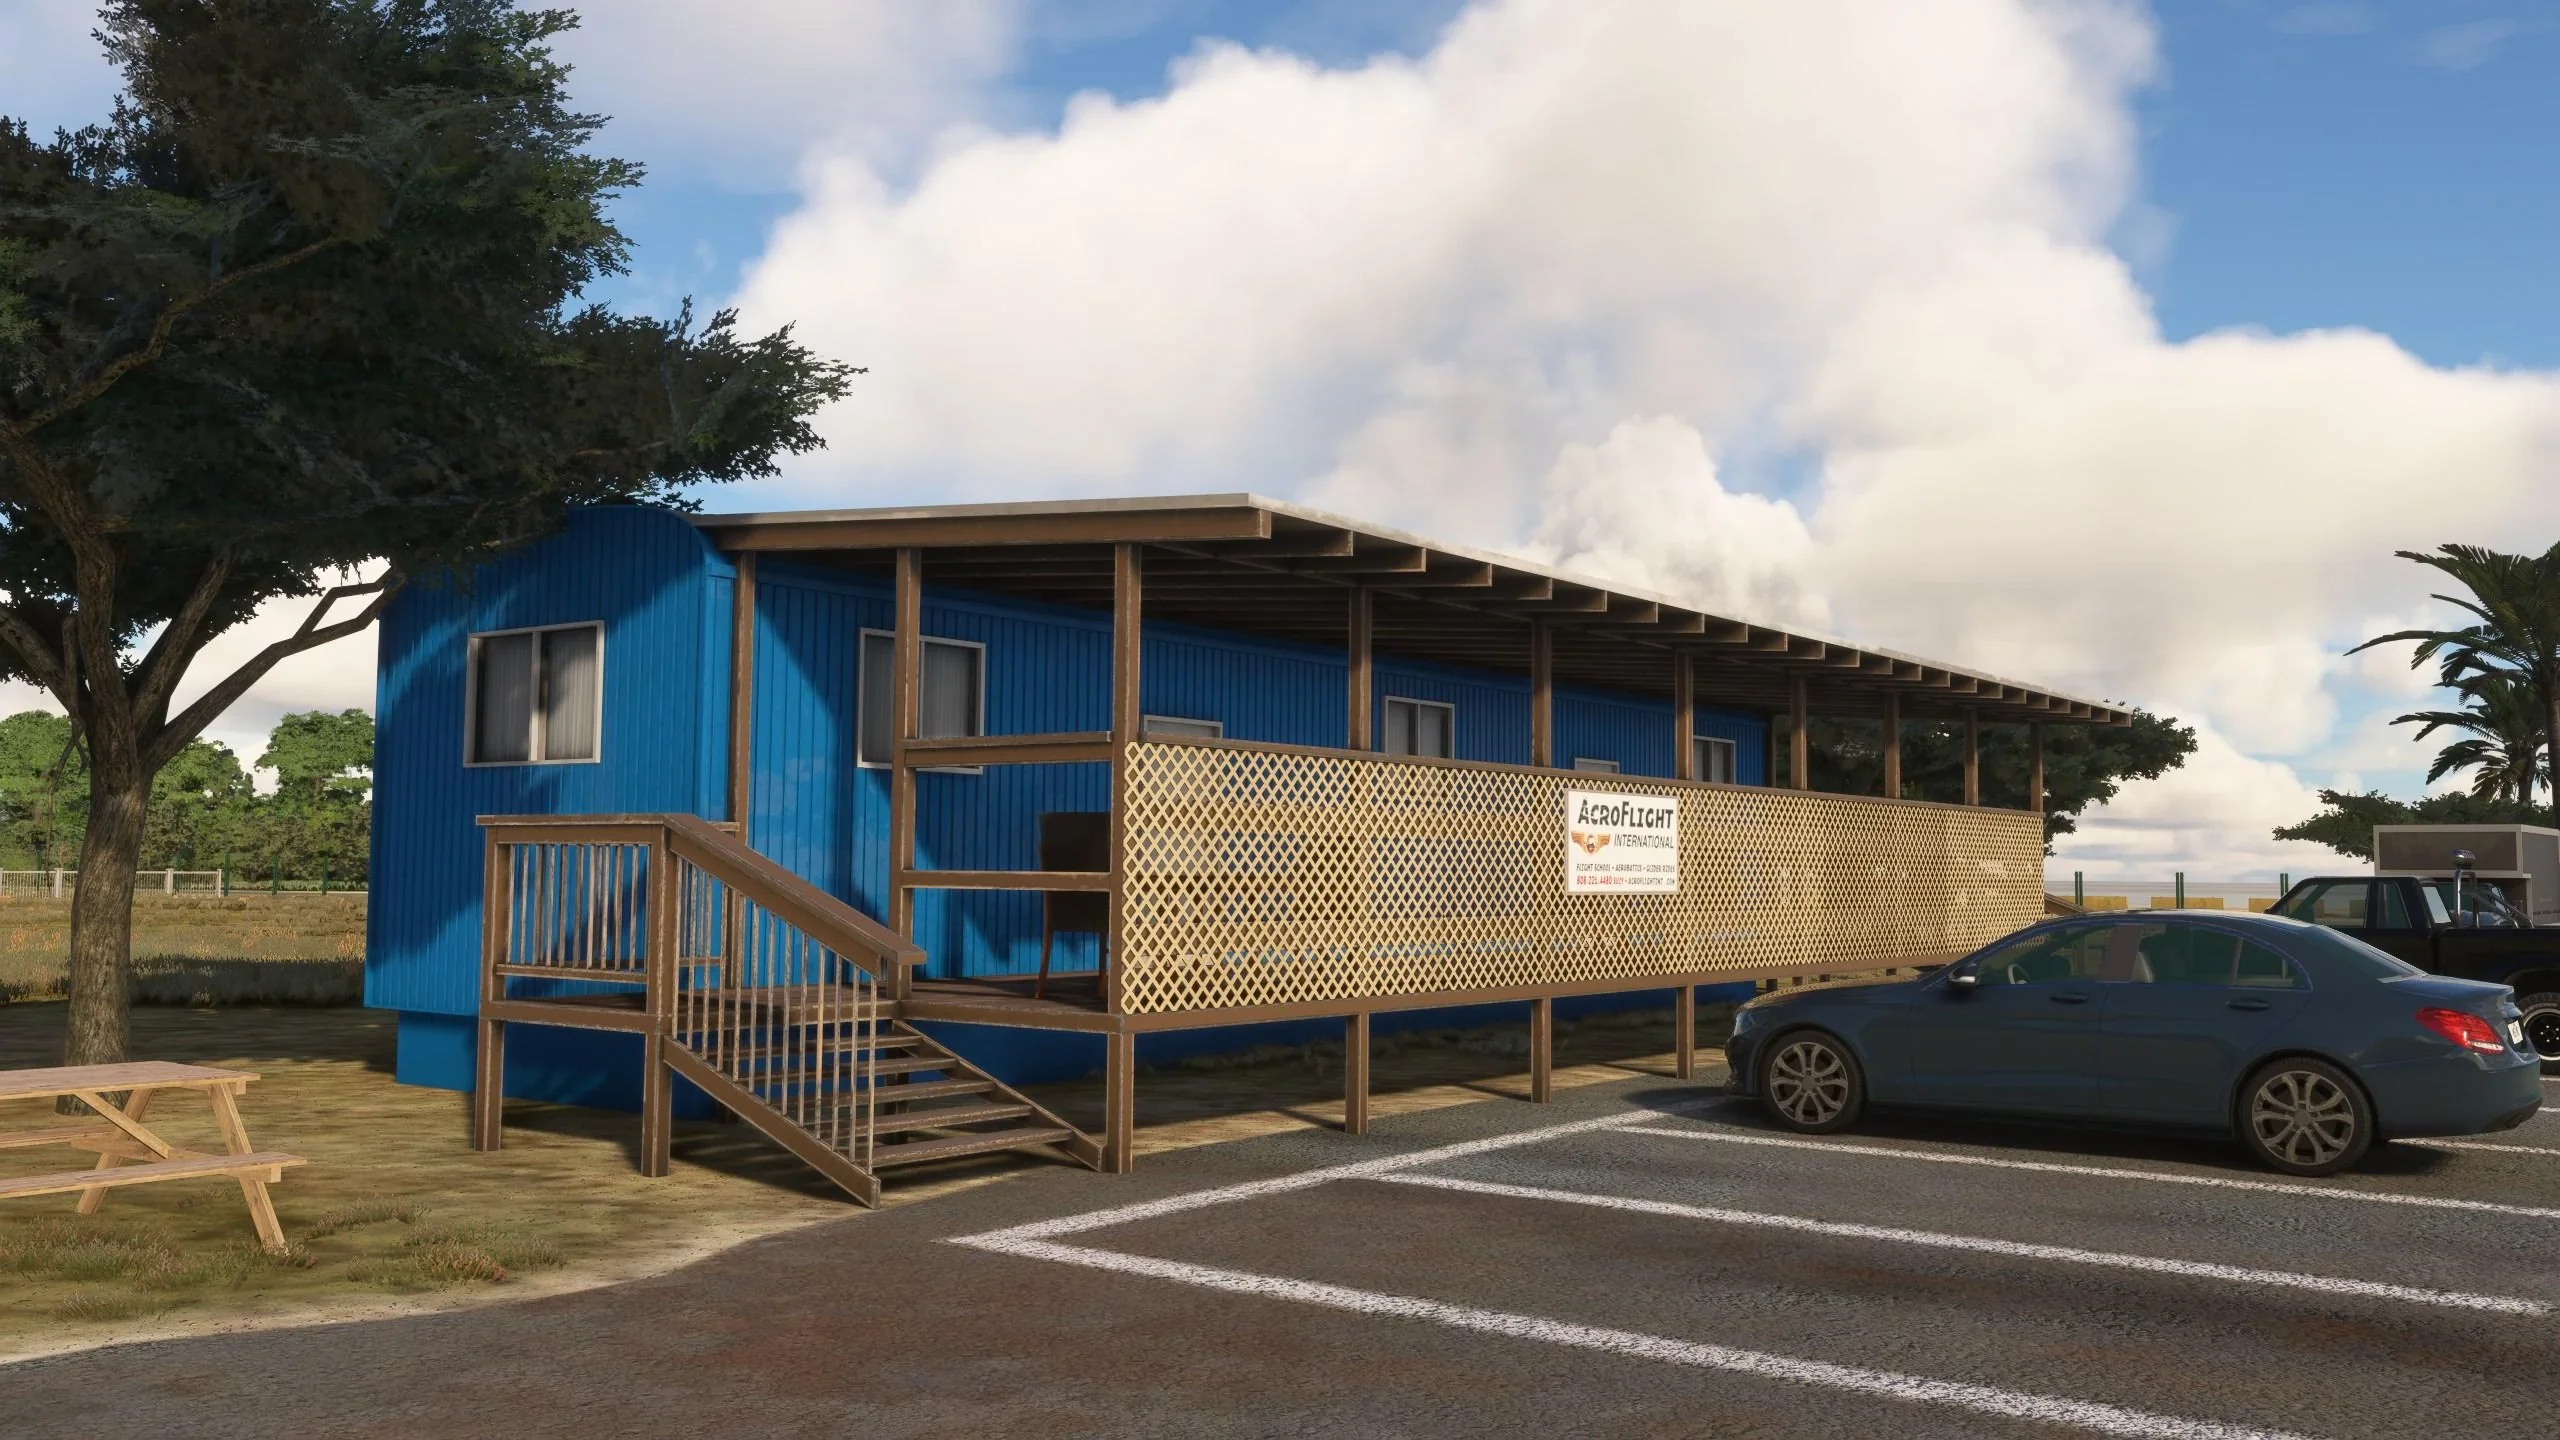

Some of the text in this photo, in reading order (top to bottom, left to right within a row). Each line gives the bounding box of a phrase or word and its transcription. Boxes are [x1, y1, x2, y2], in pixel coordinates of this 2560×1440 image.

[1614, 834, 1674, 849] INTERNATIONAL
[1576, 863, 1593, 872] FLIGHT
[1594, 863, 1611, 872] SCHOOL
